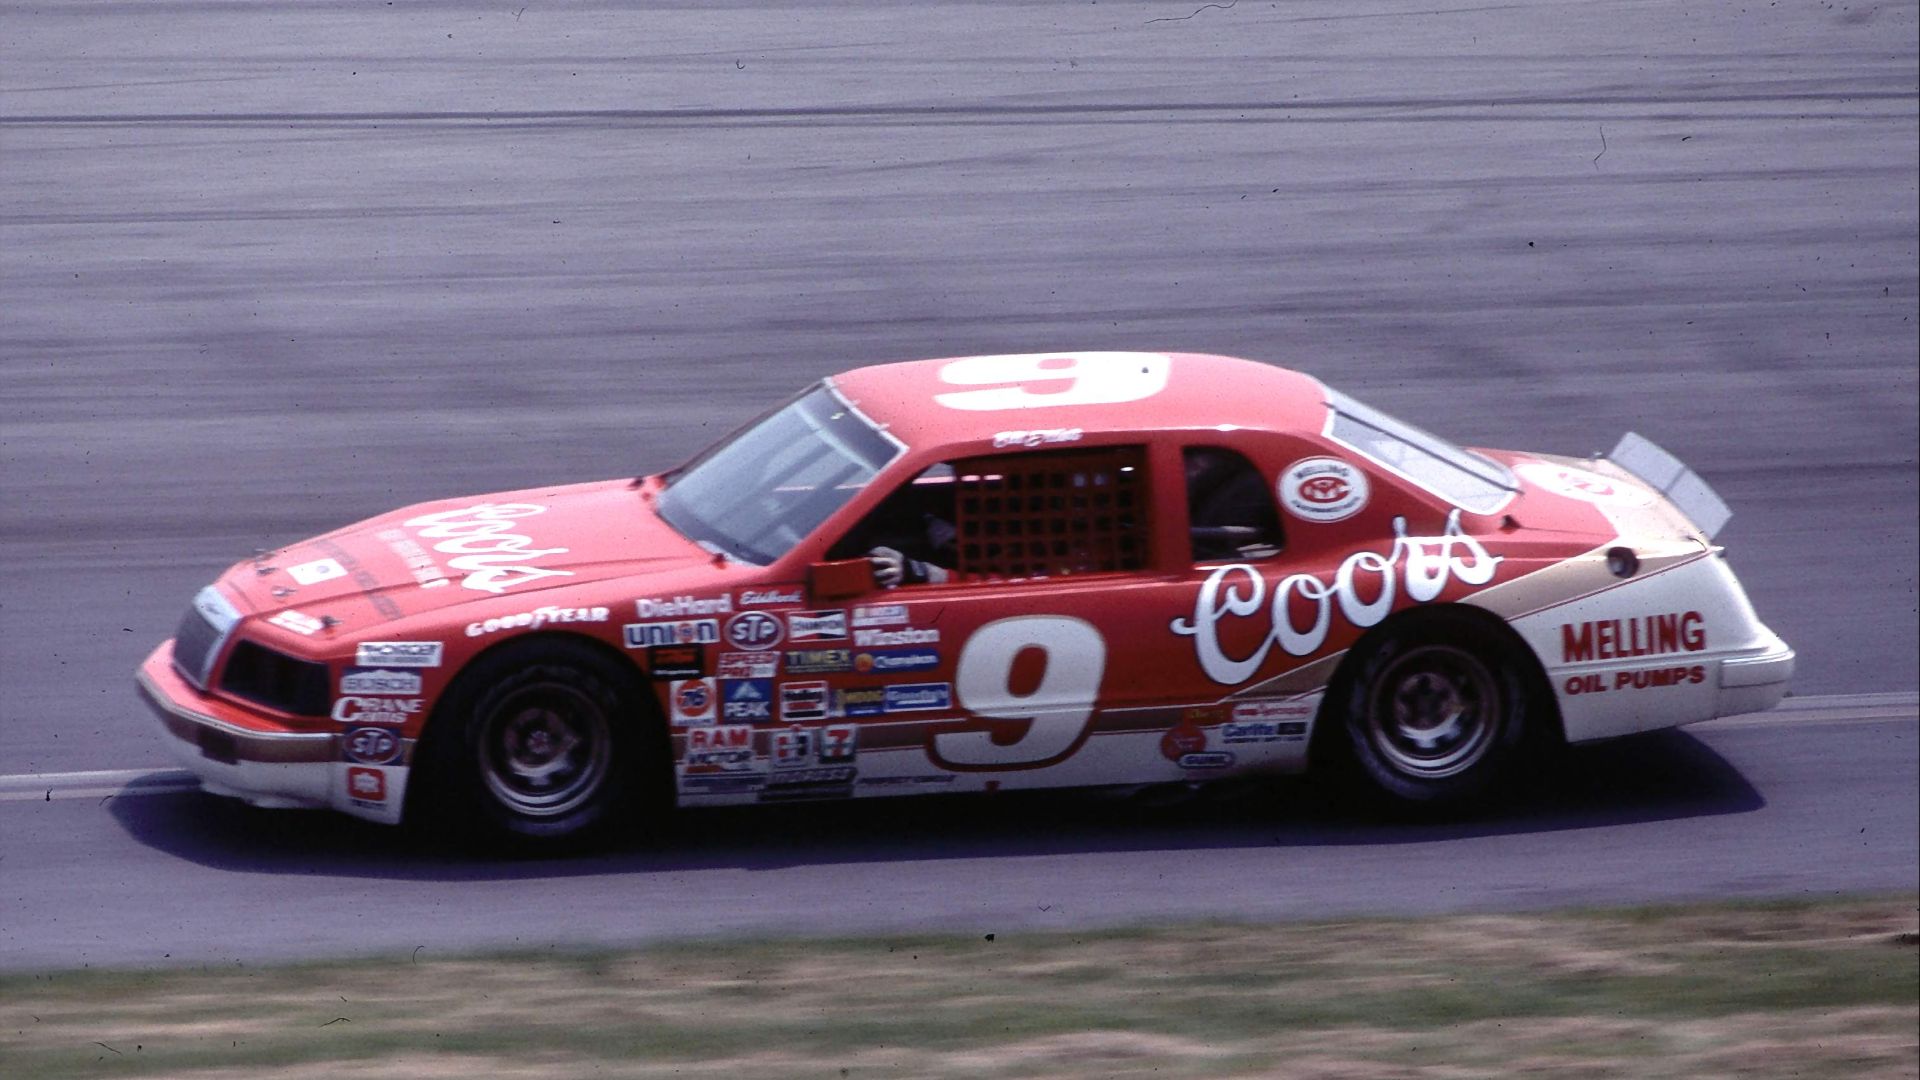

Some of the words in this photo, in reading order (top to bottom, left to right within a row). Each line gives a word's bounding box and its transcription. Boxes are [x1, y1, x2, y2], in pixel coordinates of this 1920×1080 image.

[932, 351, 1171, 411] 9
[636, 593, 732, 618] DieHard
[1169, 507, 1505, 685] Coors
[465, 605, 610, 637] GOODYEAR
[732, 615, 777, 642] STP
[854, 627, 940, 646] Winston
[1561, 611, 1707, 663] MELLING
[787, 650, 851, 667] TIMEX
[933, 614, 1107, 766] 9
[1564, 675, 1607, 695] OIL
[1615, 665, 1706, 690] PUMPS
[724, 700, 770, 718] PEAK
[352, 731, 392, 756] STP
[691, 729, 749, 748] RAM
